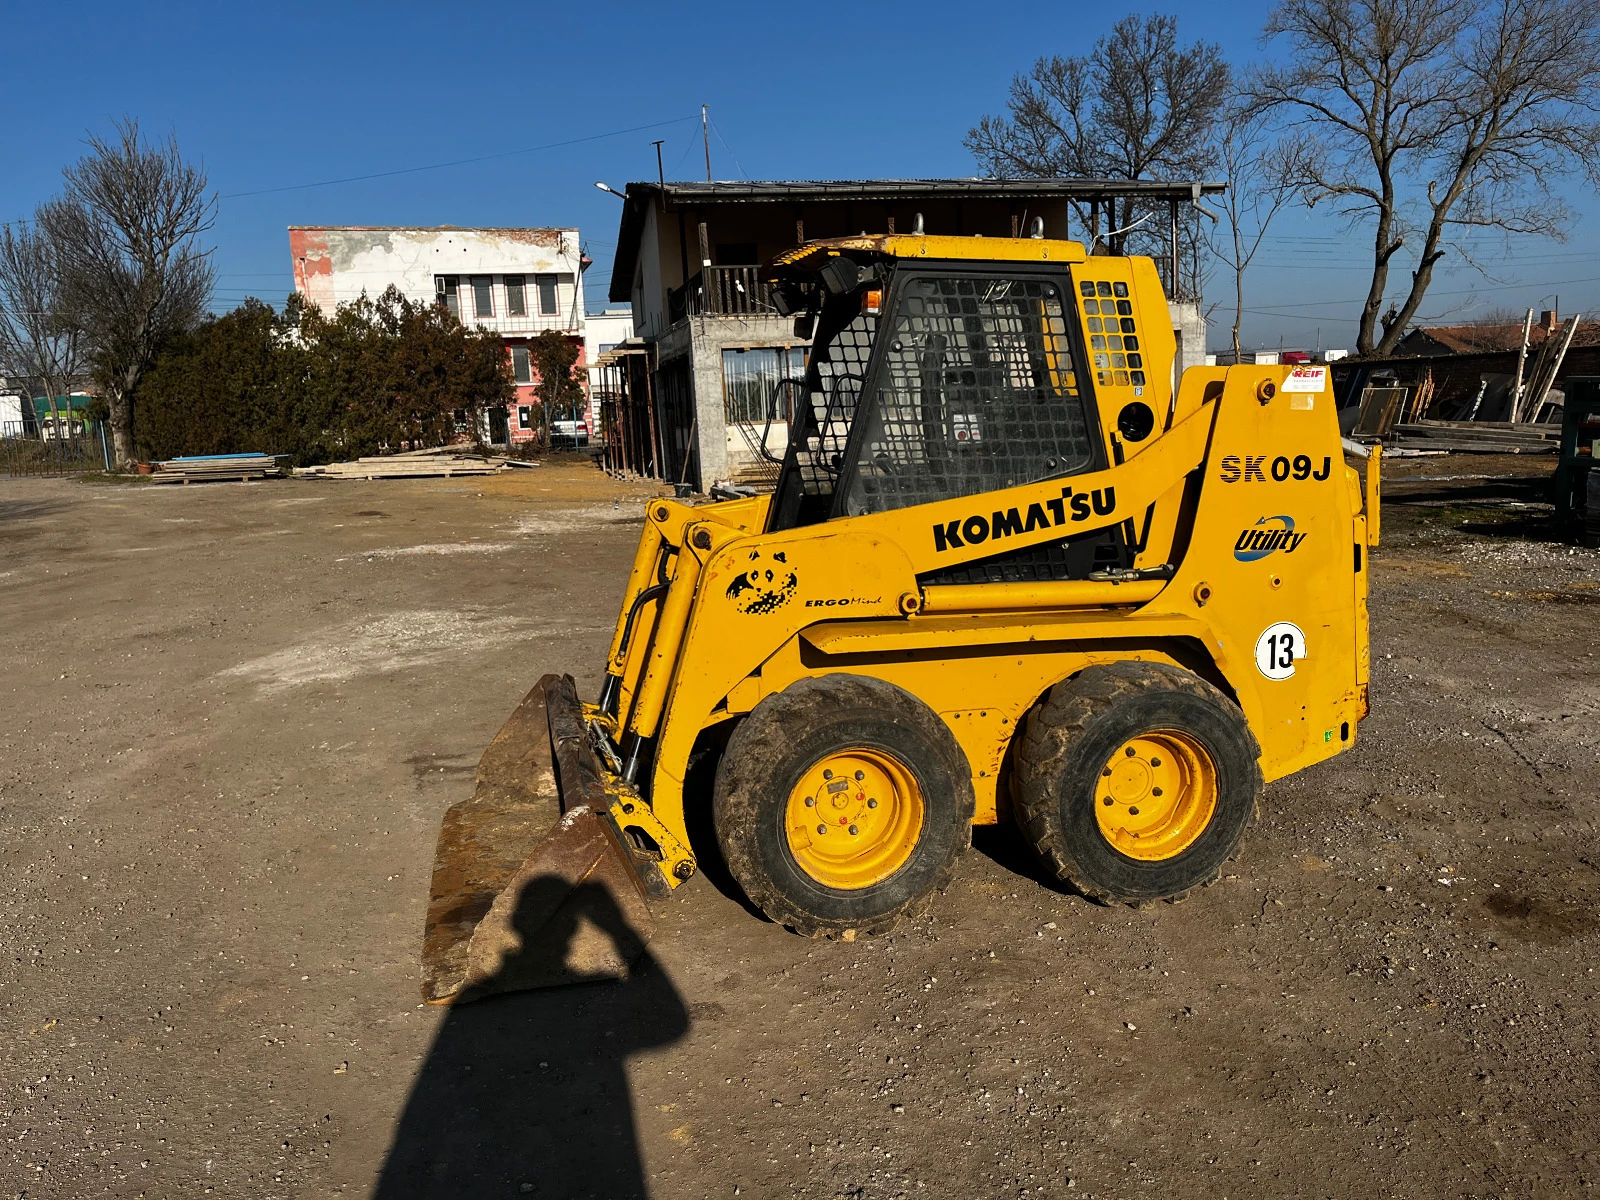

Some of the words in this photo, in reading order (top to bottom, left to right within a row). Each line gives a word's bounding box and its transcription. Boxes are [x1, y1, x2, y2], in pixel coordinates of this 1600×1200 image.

[1292, 370, 1324, 378] REIF
[932, 486, 1116, 552] KOMATSU
[1234, 529, 1308, 554] Utility
[1267, 633, 1294, 670] 13
